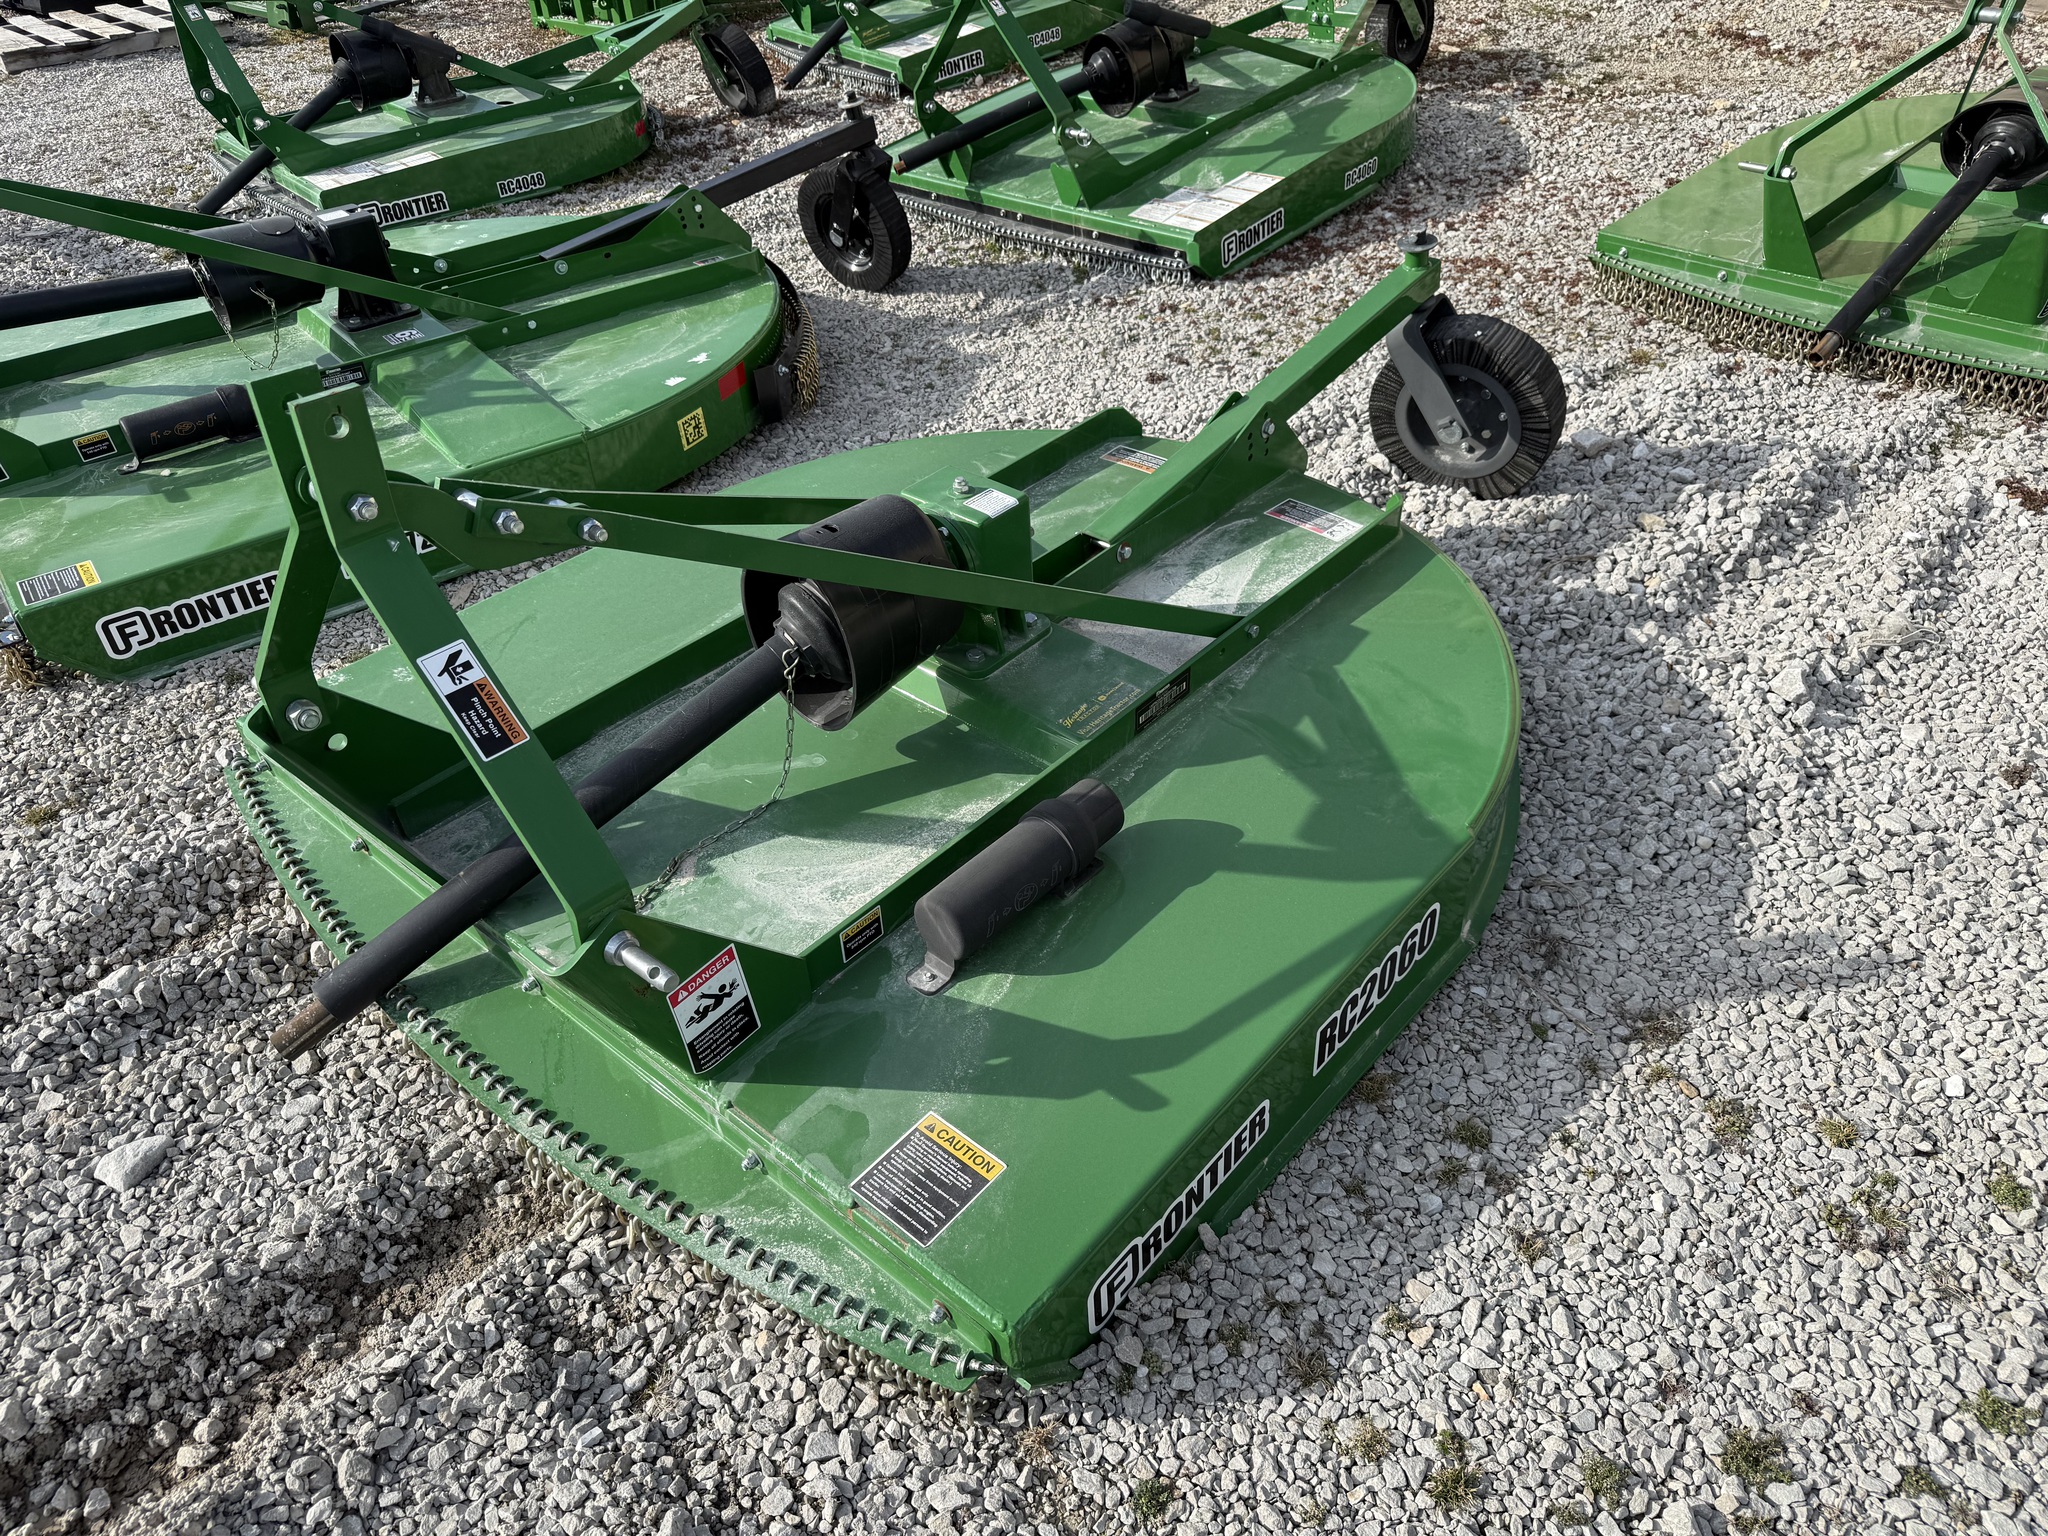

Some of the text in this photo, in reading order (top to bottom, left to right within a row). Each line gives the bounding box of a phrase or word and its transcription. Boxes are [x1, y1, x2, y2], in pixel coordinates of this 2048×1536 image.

[500, 173, 545, 196] RC4048
[1344, 158, 1378, 189] RC4060
[352, 192, 448, 226] RONTIER
[1222, 210, 1284, 266] FRONTIER
[82, 433, 107, 444] CAUTION
[461, 712, 480, 738] Keep Clear
[468, 710, 489, 736] Hazard
[471, 697, 502, 738] Pinch Point
[484, 690, 520, 740] WARNING
[850, 910, 879, 934] CAUTION
[688, 954, 730, 992] DANGER
[1315, 907, 1438, 1074] RC2060
[918, 1135, 933, 1147] Avoid
[930, 1144, 949, 1159] Serious
[946, 1156, 963, 1169] Injury:
[936, 1129, 996, 1174] CAUTION
[1090, 1104, 1266, 1330] FRONTIER
